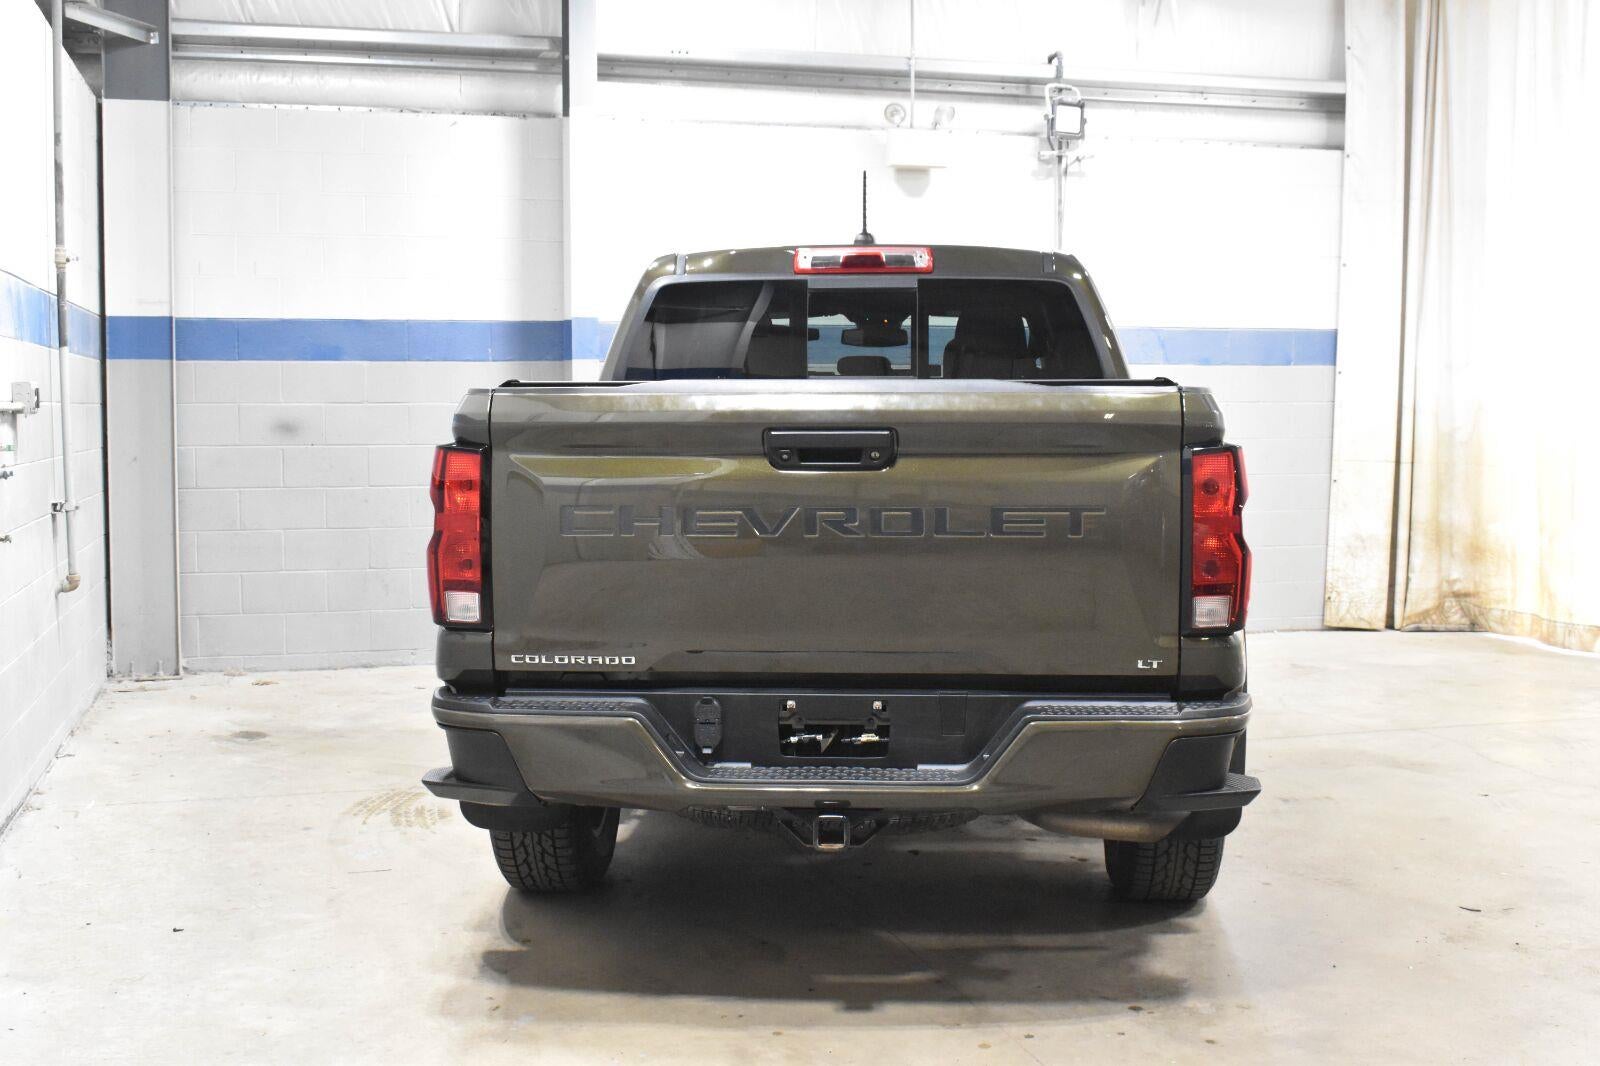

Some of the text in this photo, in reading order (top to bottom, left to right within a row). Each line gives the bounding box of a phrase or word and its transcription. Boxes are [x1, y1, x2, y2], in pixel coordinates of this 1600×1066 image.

[559, 504, 1107, 538] CHEVROLET
[510, 654, 636, 665] COLORADO
[1137, 659, 1163, 669] LT
